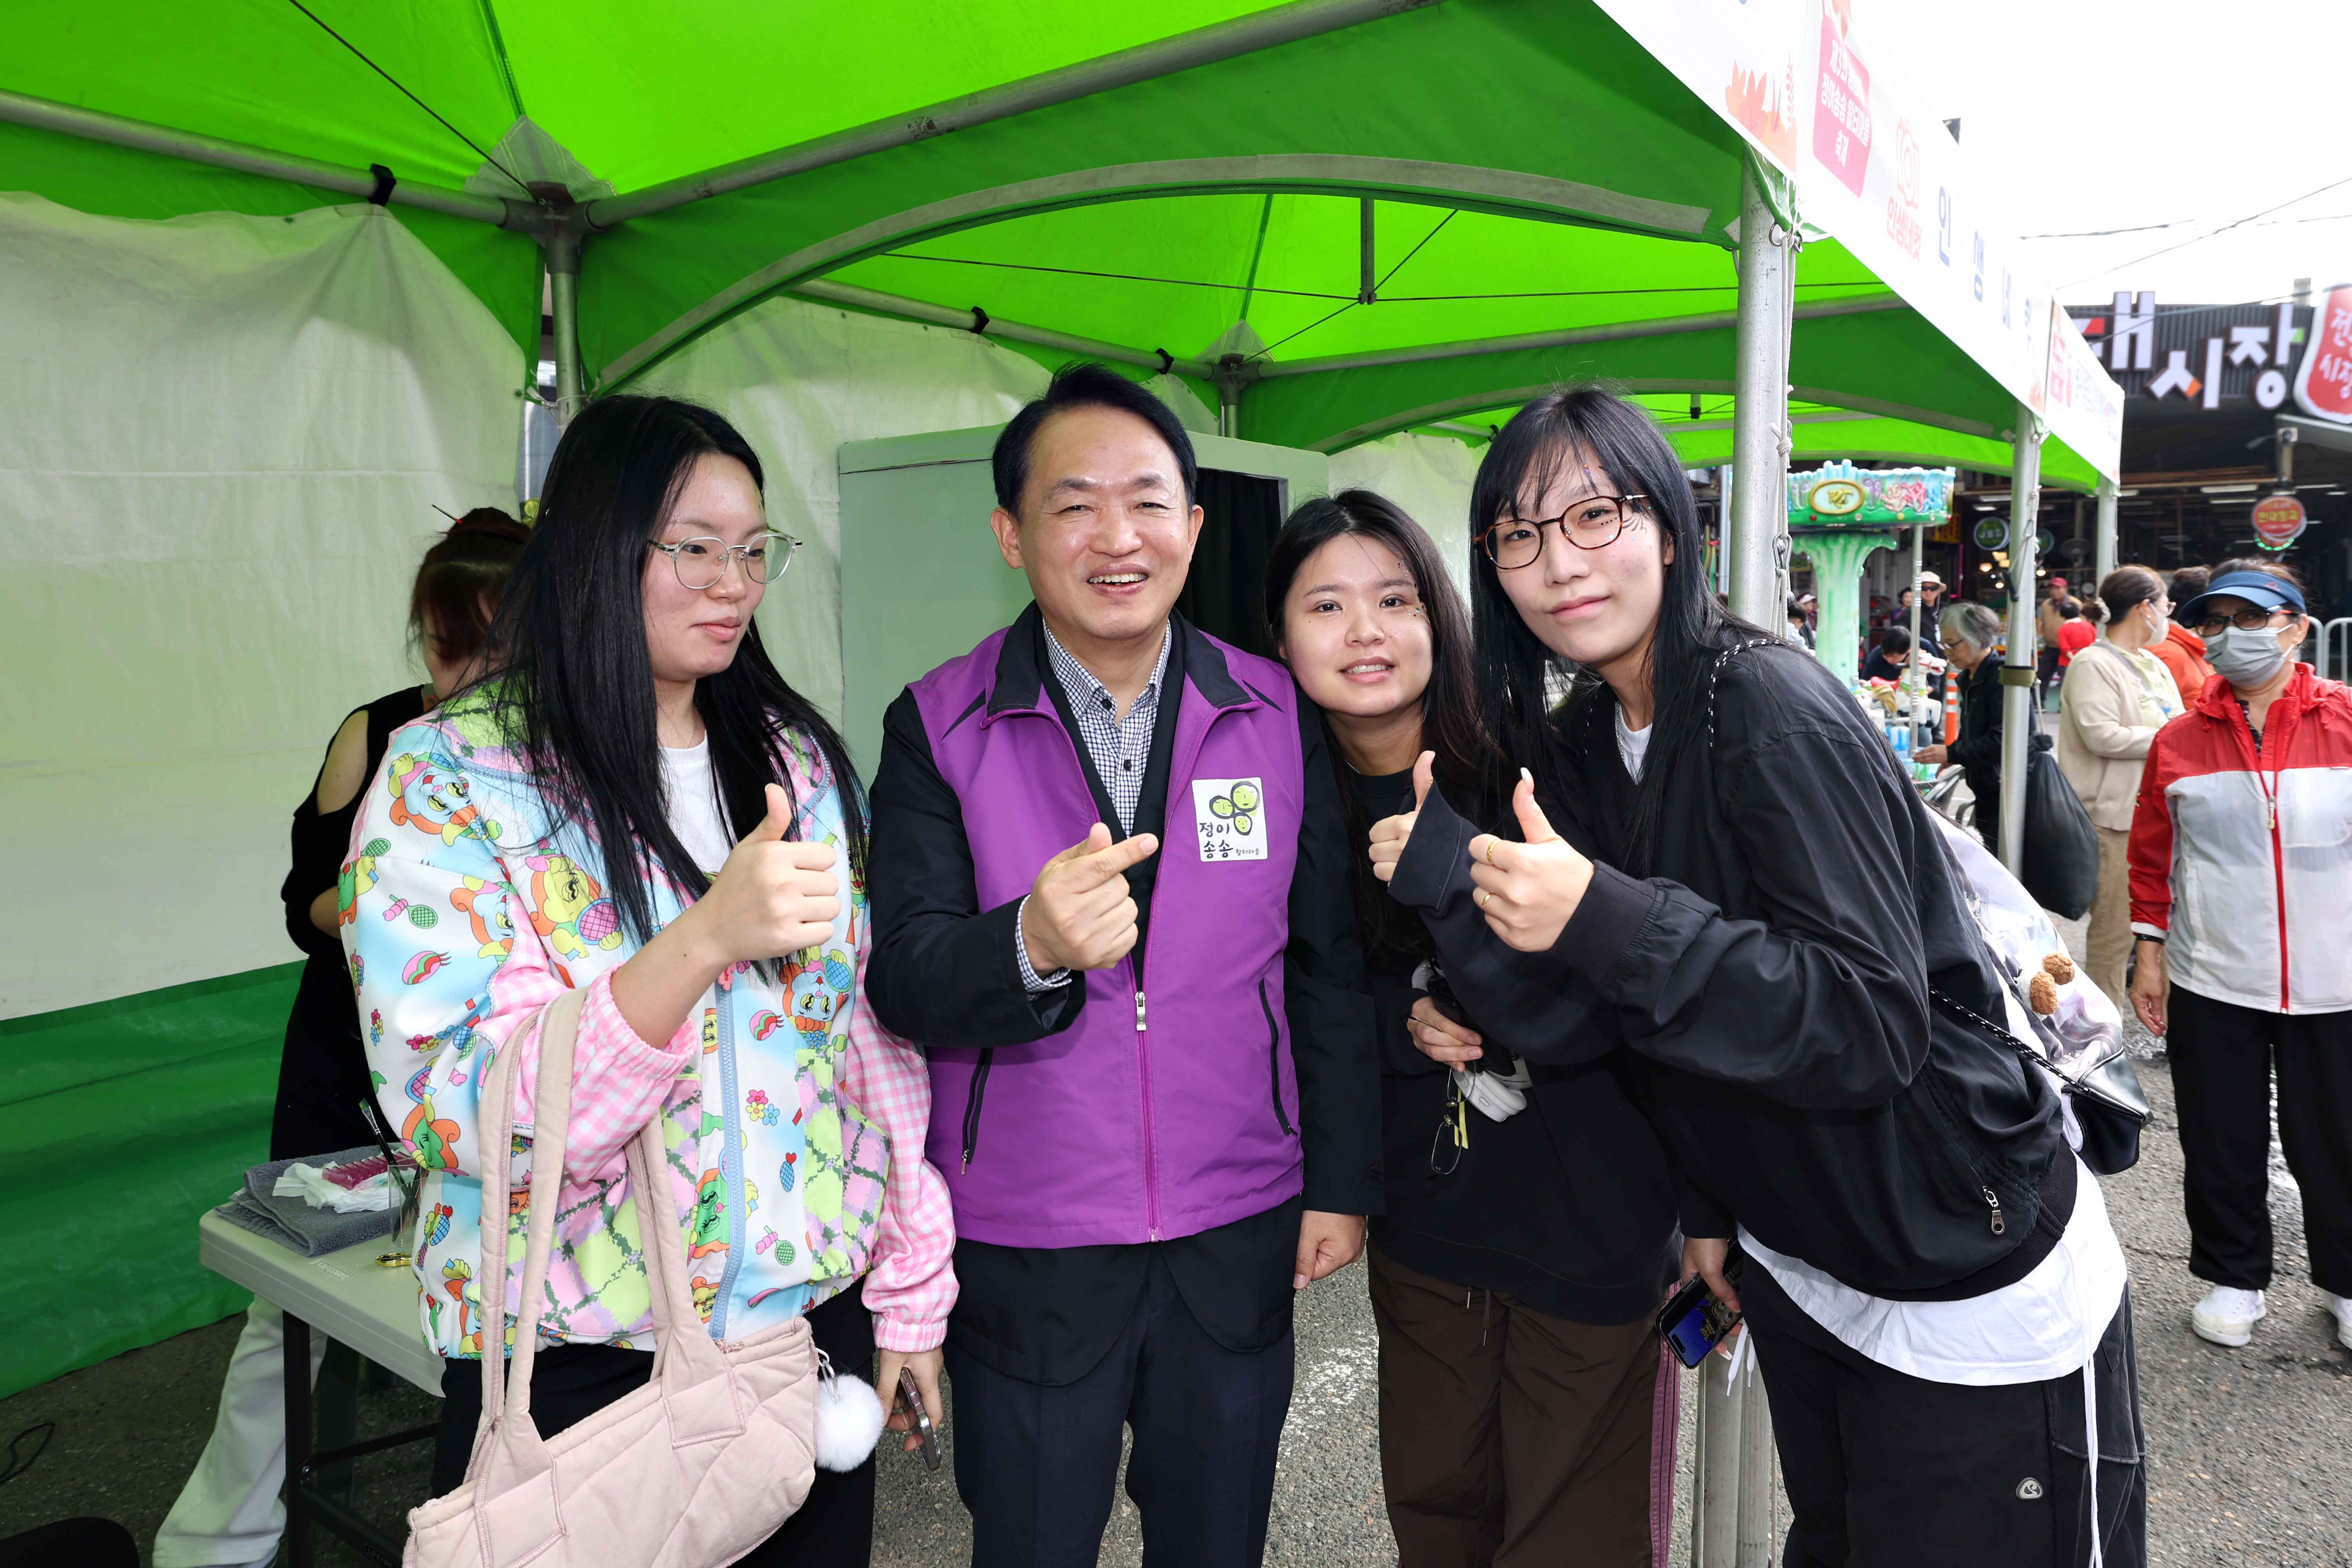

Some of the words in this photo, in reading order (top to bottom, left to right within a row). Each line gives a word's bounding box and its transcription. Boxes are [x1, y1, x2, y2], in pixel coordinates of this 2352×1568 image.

[1821, 71, 1847, 125] 정이송송
[1835, 129, 1849, 168] 축제
[1887, 196, 1922, 264] 인생네컷
[1199, 822, 1230, 837] 정이
[1203, 839, 1234, 859] 송송
